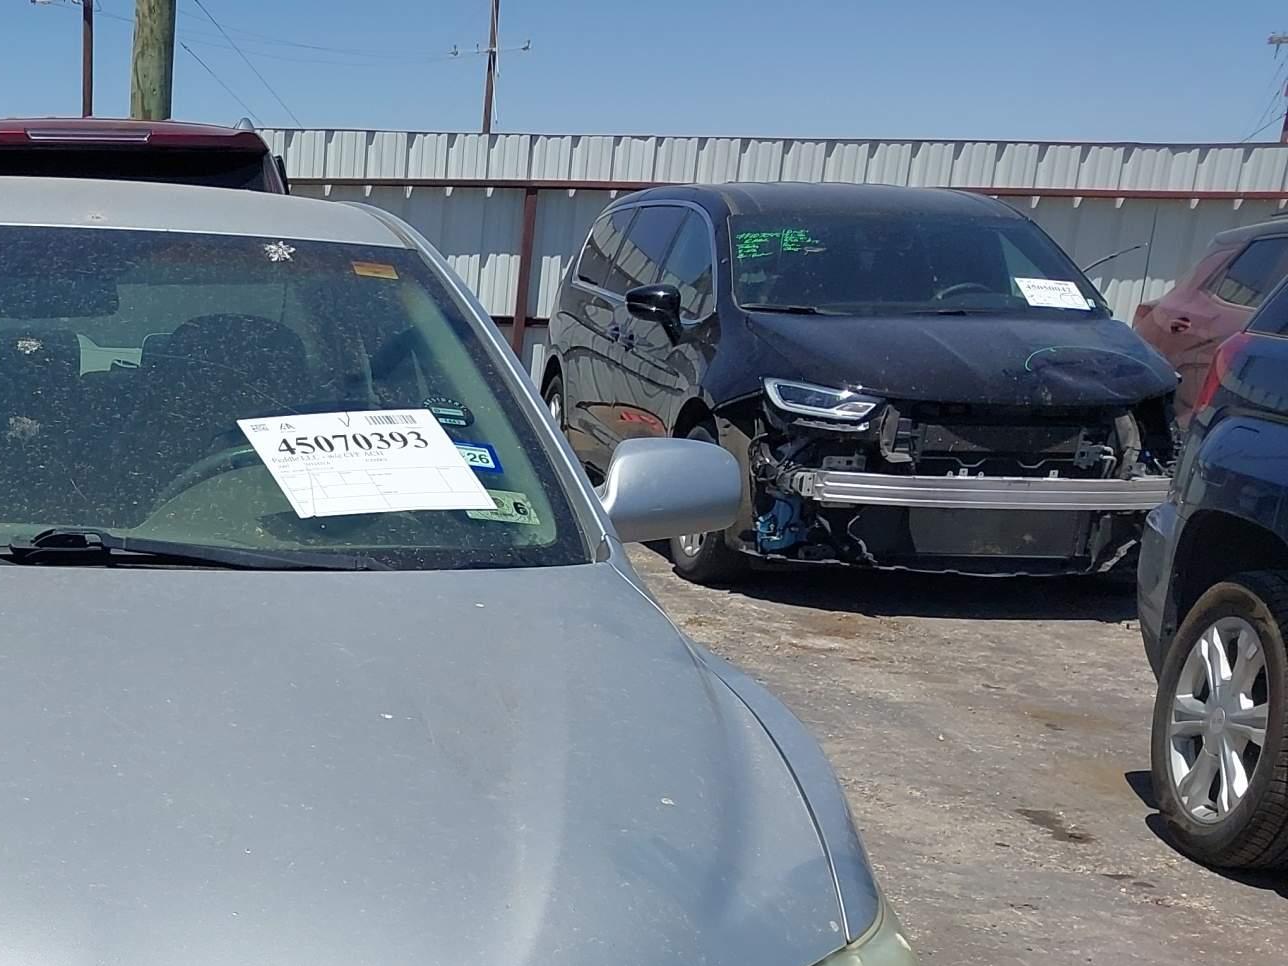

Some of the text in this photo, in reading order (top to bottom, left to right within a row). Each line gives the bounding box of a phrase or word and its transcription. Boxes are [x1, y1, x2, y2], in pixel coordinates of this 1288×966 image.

[278, 431, 429, 455] 45070393
[466, 452, 490, 464] 26
[513, 502, 529, 516] 6
